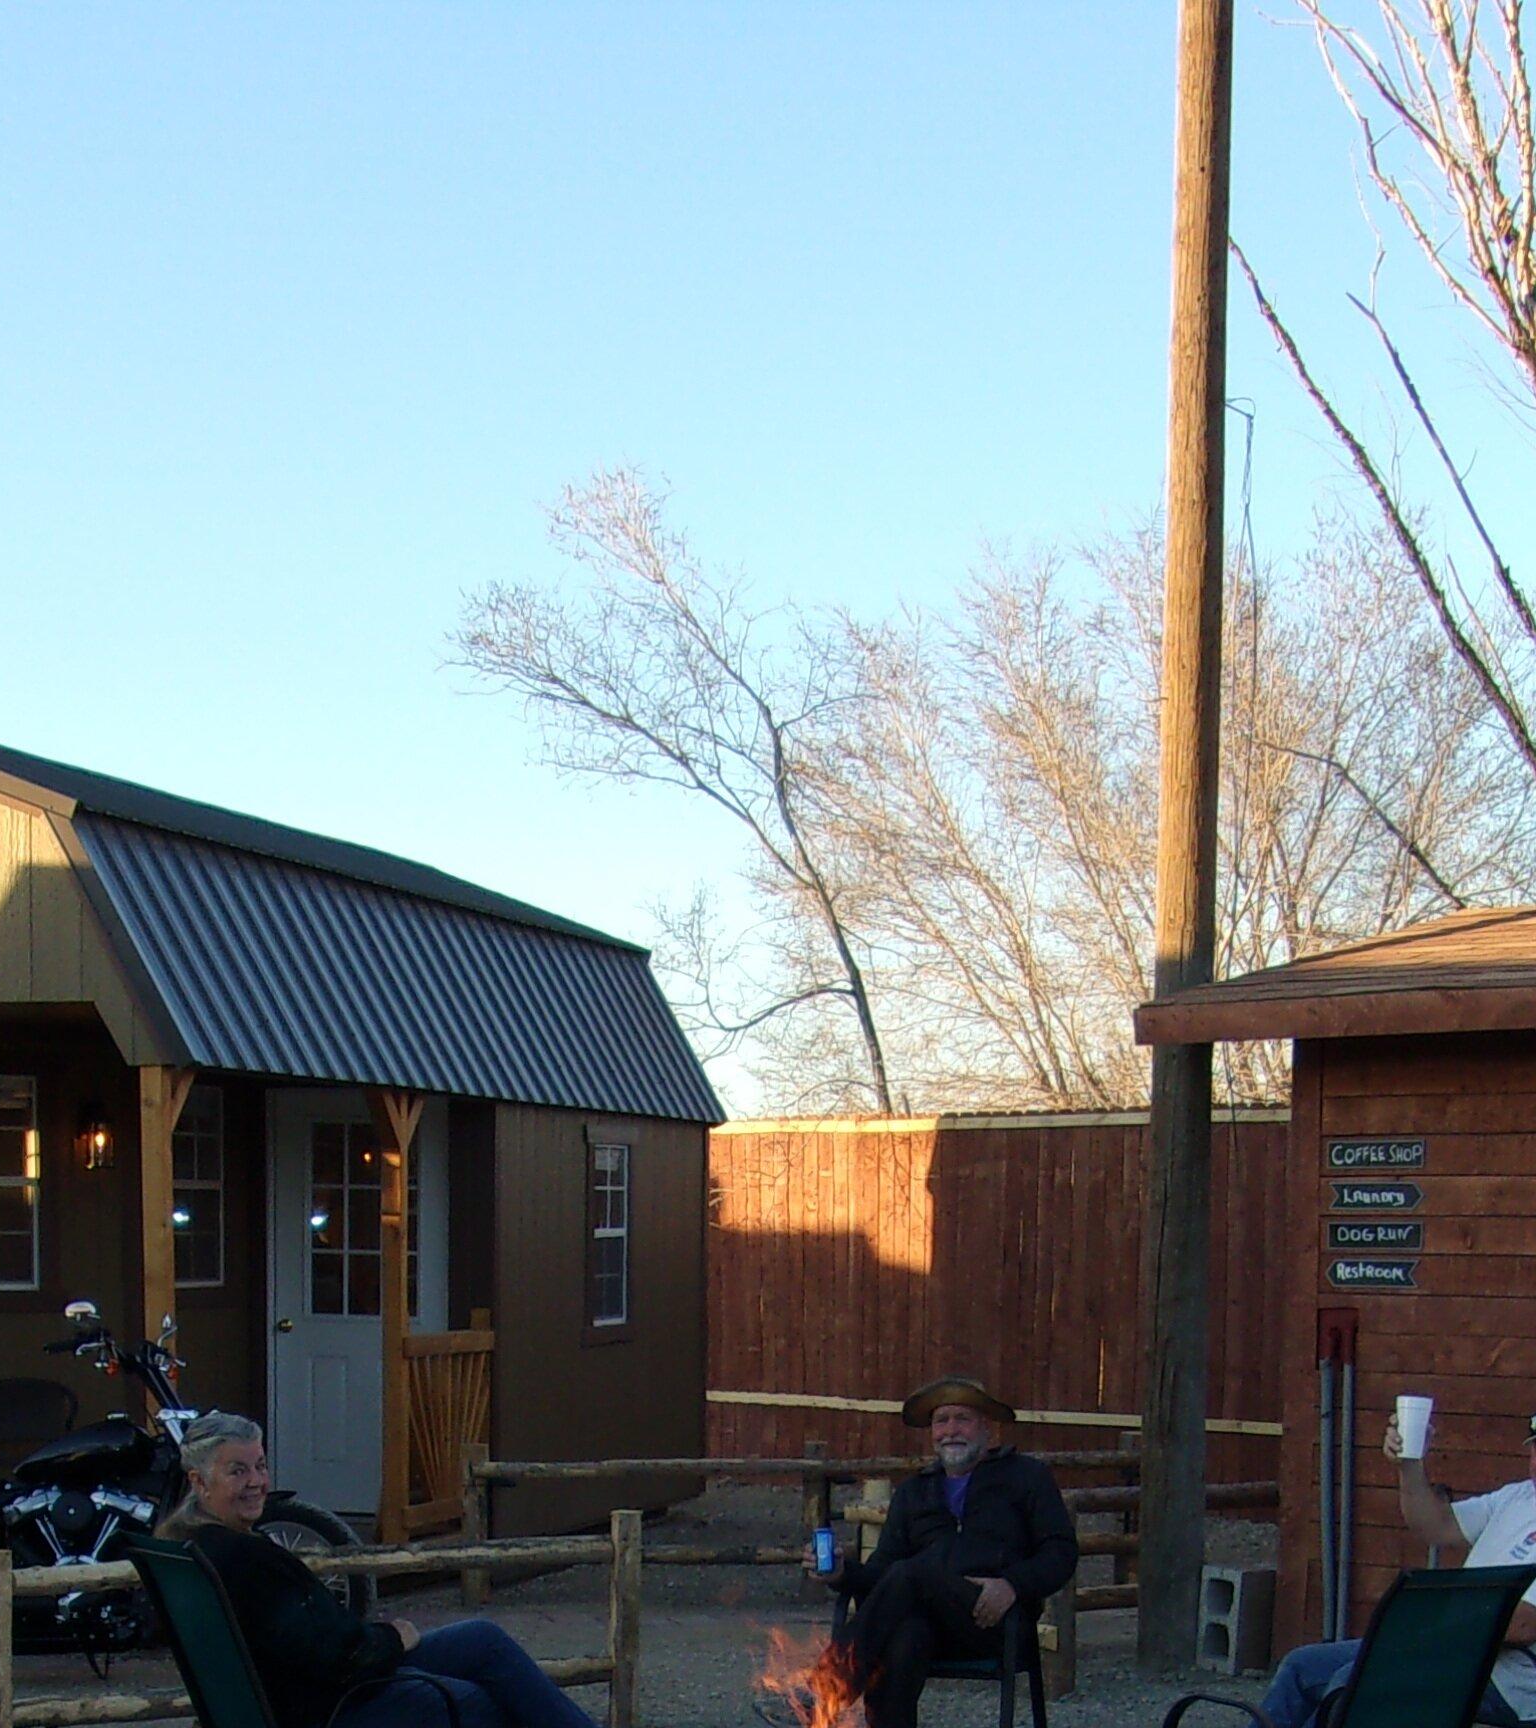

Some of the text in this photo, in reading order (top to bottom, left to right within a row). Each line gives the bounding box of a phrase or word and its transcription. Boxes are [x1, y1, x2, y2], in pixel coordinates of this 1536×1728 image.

[1331, 1144, 1423, 1165] COFFEE SHOP
[1337, 1225, 1414, 1242] DOG RUN
